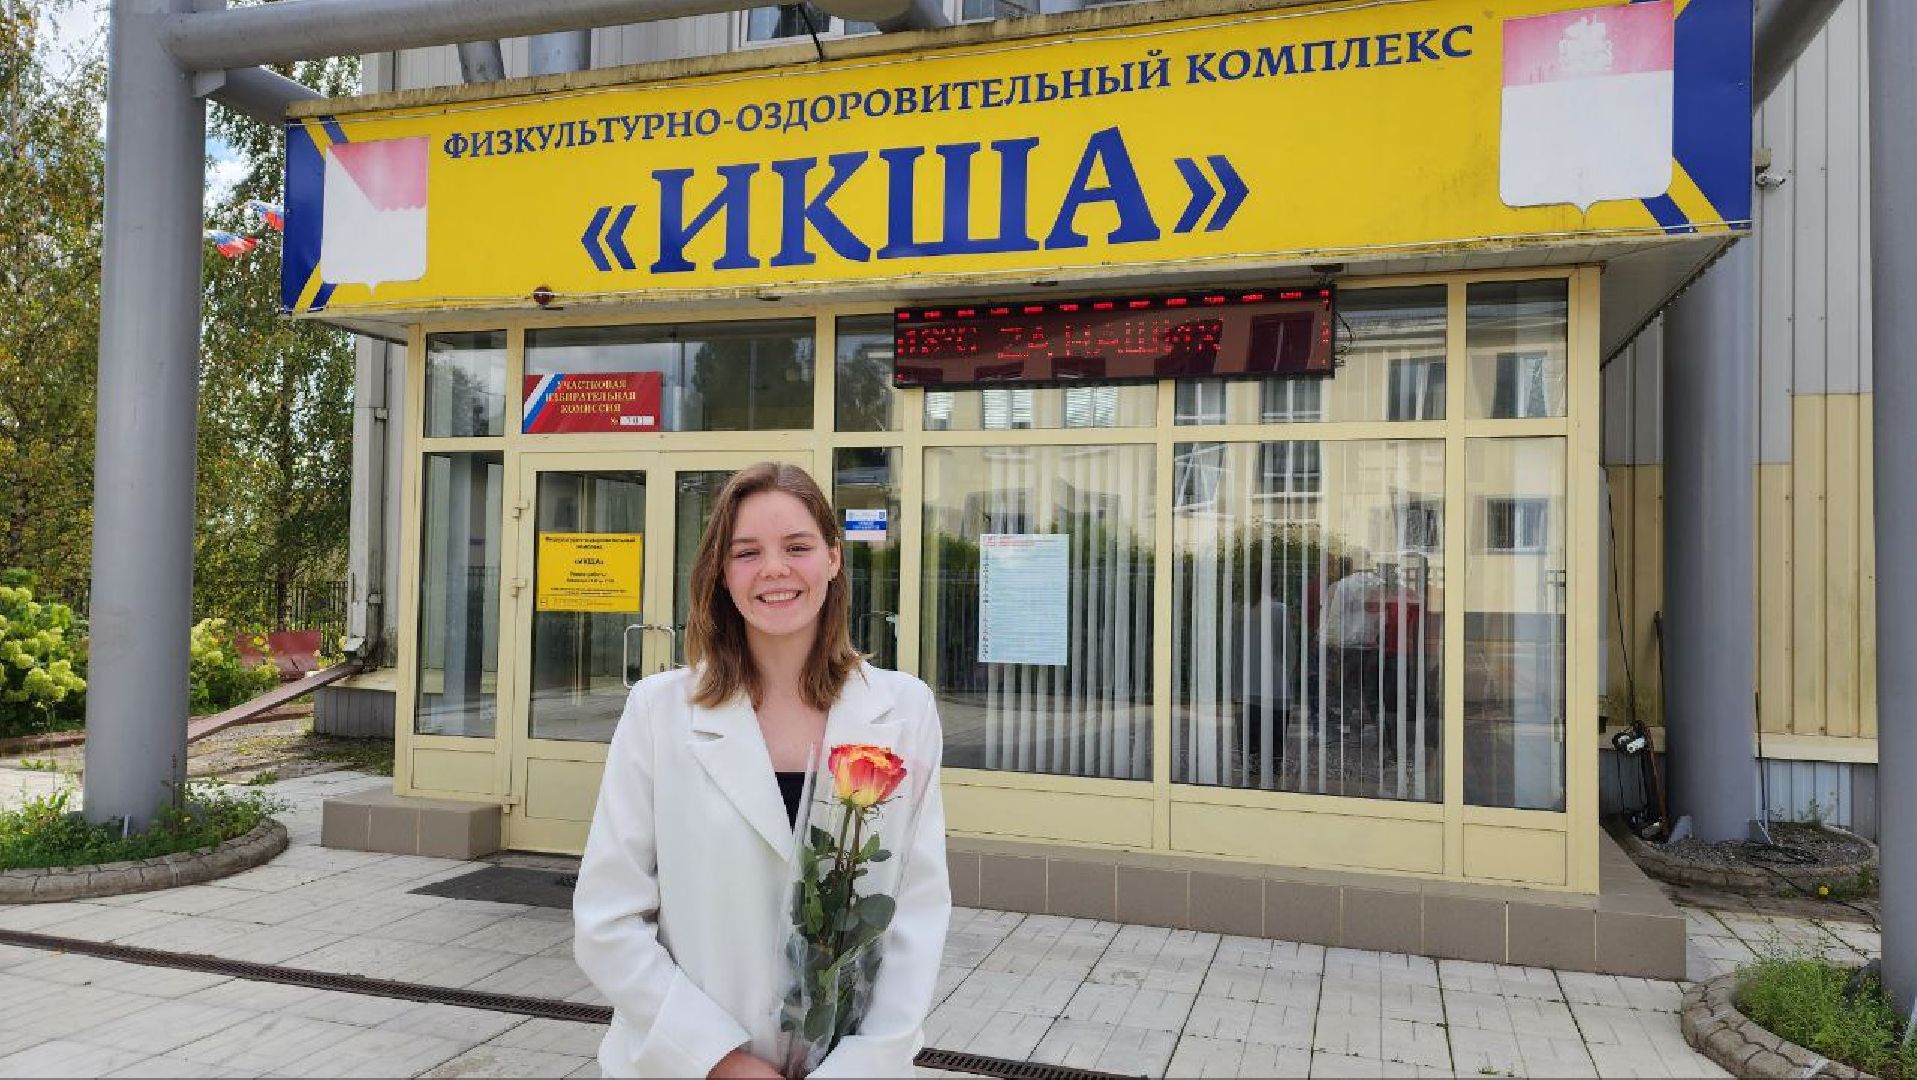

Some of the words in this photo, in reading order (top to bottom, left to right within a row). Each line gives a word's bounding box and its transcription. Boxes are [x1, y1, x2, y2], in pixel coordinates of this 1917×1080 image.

[443, 49, 1171, 159] ФИЗКУЛЬТУРНО-ОЗДОРОВИТЕЛЬНЫЙ
[1185, 25, 1473, 85] КОМПЛЕКС
[581, 126, 1250, 274] «ИКША»
[557, 380, 627, 390] УЧАСТКОВАЯ
[545, 391, 636, 402] ИЗБИРАТЕЛЬНАЯ
[560, 403, 621, 414] КОМИССИЯ
